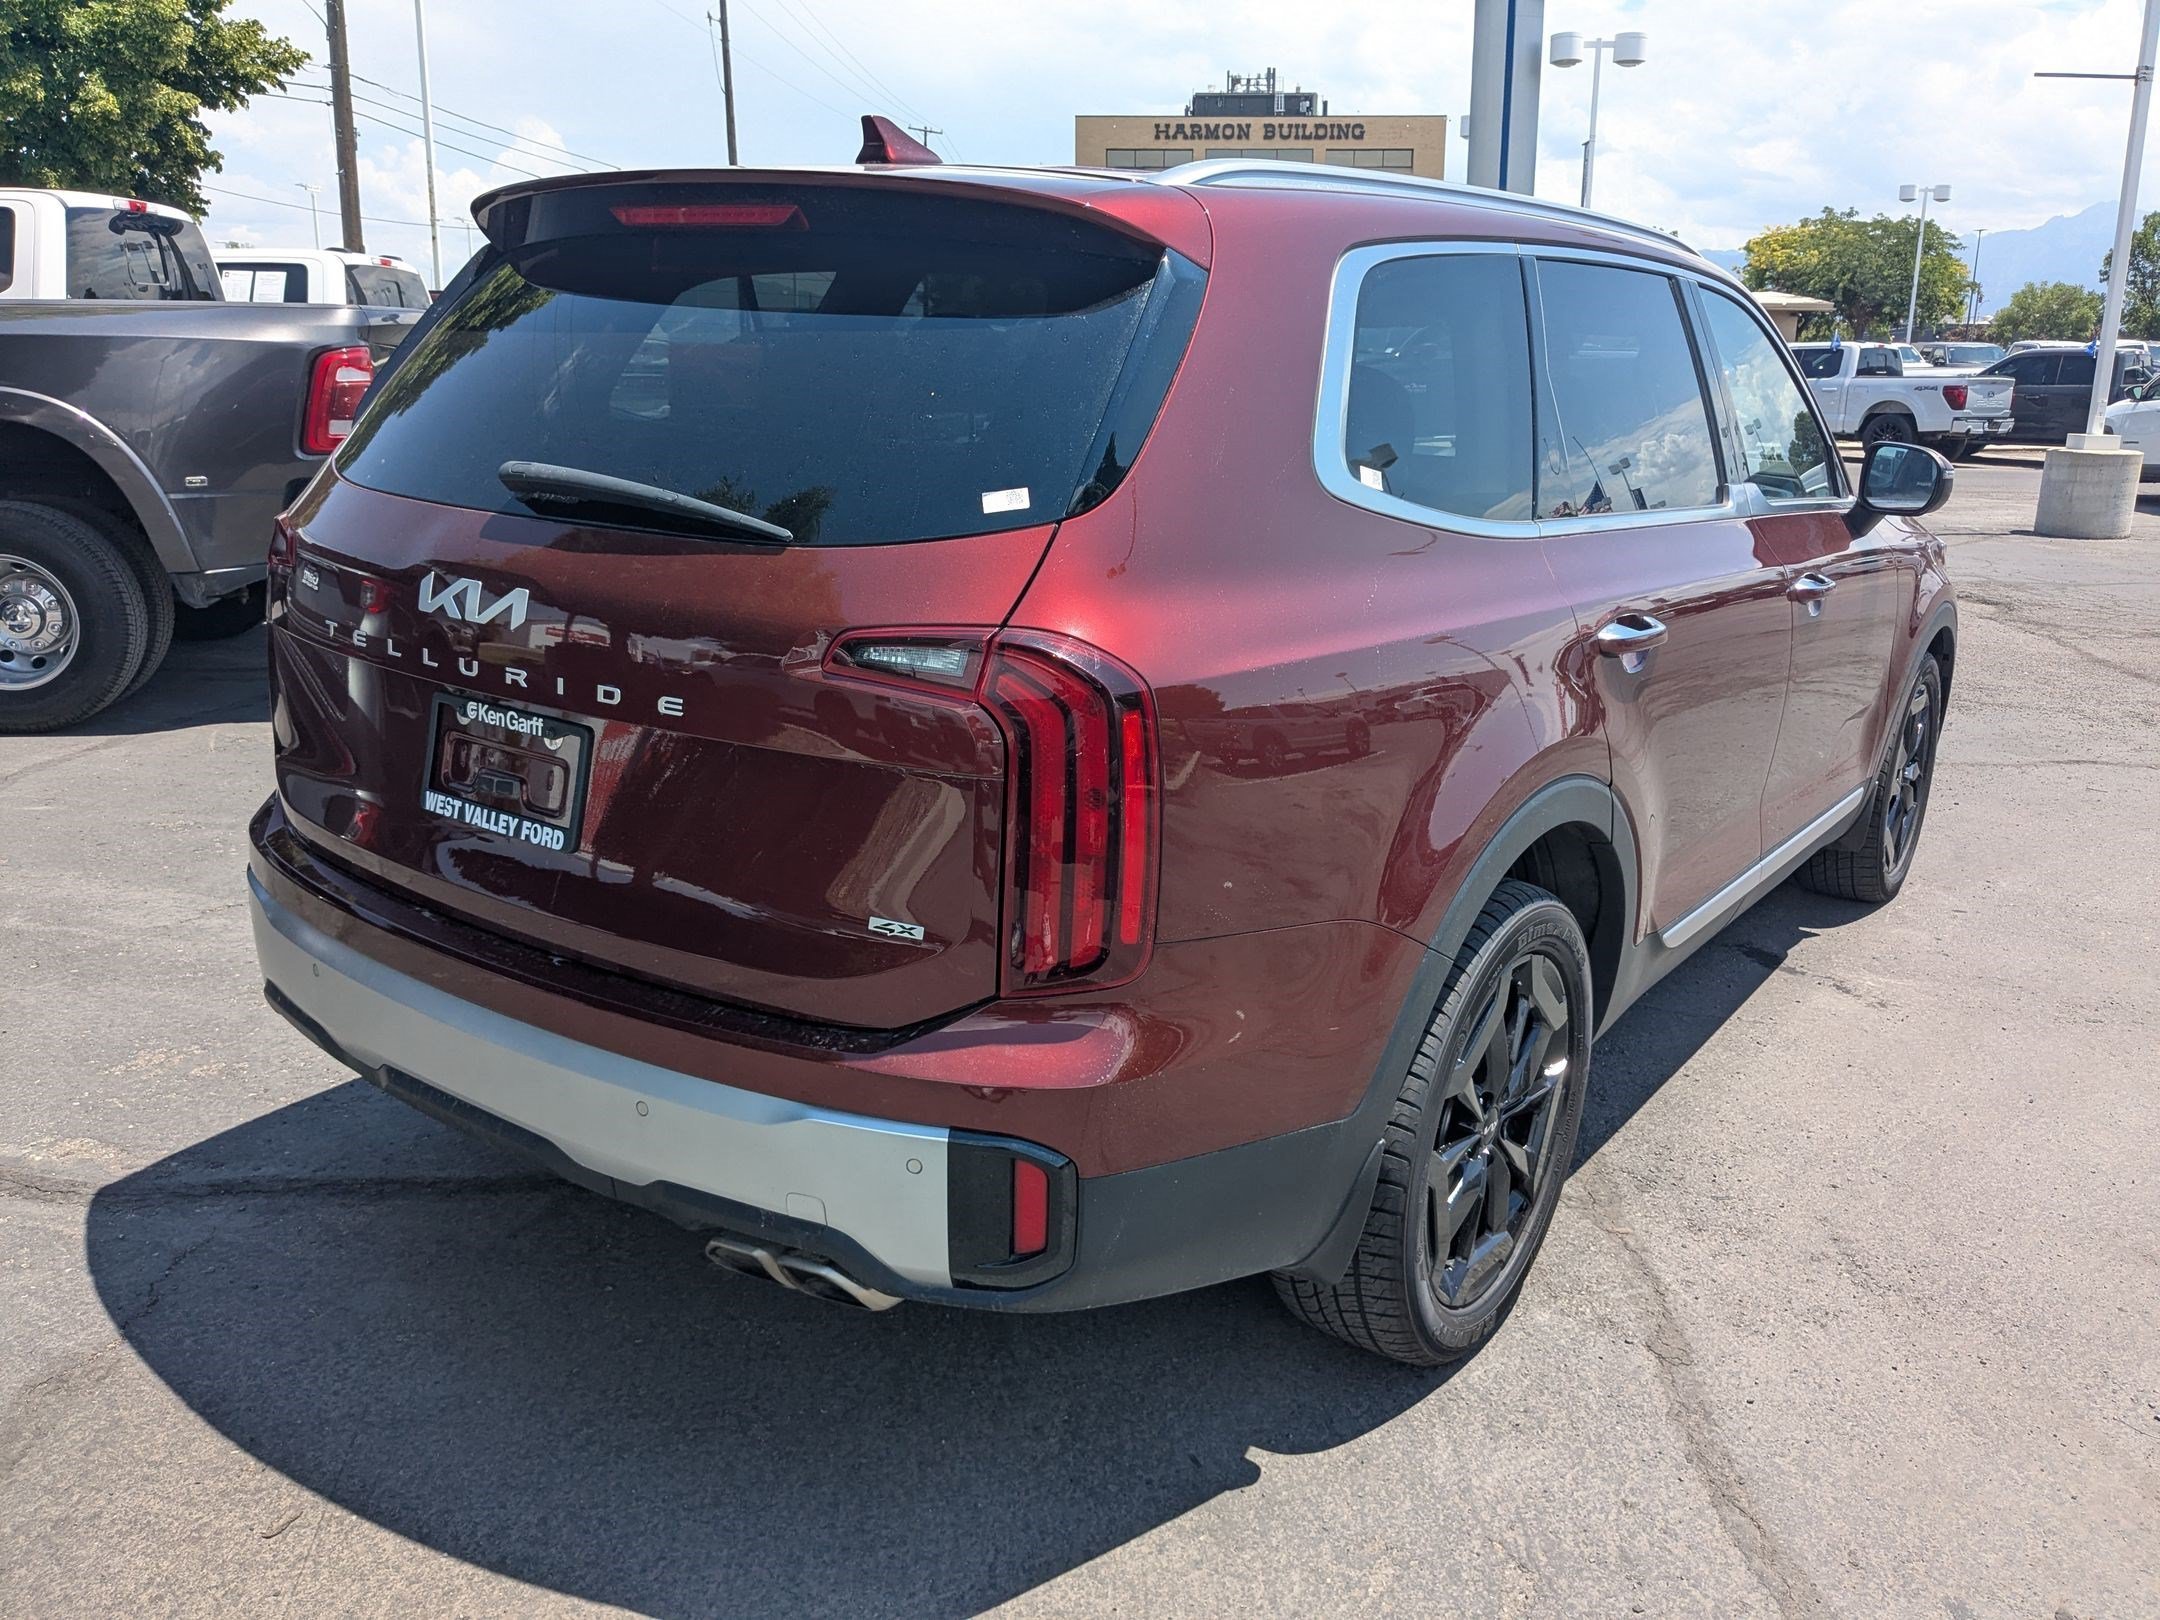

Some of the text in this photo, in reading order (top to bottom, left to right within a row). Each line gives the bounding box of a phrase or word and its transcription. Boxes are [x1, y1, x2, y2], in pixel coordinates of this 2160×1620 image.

[1154, 123, 1366, 141] HARMON BUILDING
[418, 571, 530, 633] KIA
[325, 619, 685, 717] TELLURIDE
[506, 710, 544, 737] Garff
[425, 790, 565, 851] WEST VALLEY FORD
